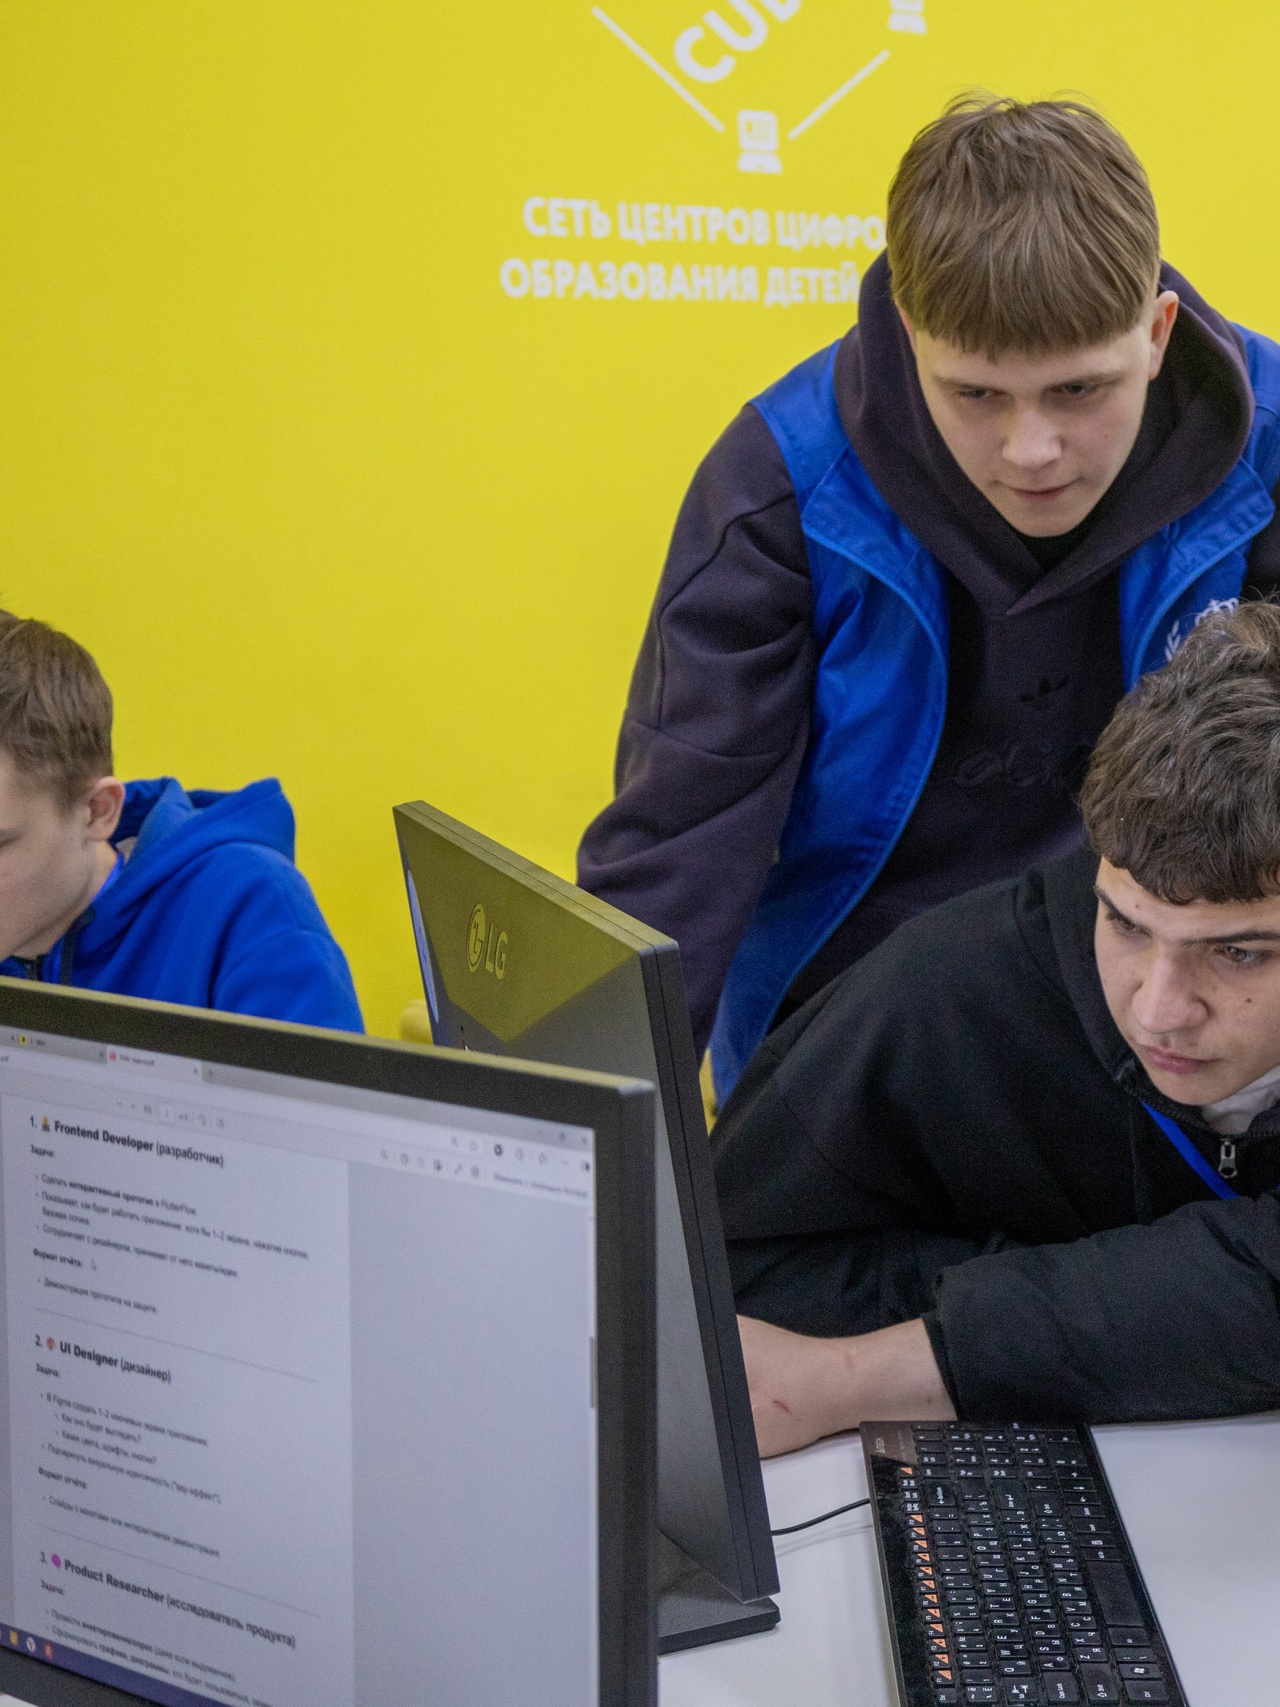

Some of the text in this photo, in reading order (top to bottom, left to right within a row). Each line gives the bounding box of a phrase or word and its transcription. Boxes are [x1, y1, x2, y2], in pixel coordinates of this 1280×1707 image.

[522, 195, 886, 252] СЕТЬ ЦЕНТРОВ ЦИФРО
[500, 257, 860, 308] ОБРАЗОВАНИЯ ДЕТЕЙ
[484, 923, 508, 980] LG
[54, 1121, 98, 1139] Frontend
[102, 1130, 152, 1152] Developer
[156, 1140, 223, 1168] (разработчик)
[59, 1341, 70, 1354] UI
[73, 1345, 118, 1368] Designer
[120, 1357, 171, 1384] (дизайнер)
[64, 1558, 103, 1581] Product
[105, 1573, 164, 1603] Researcher
[167, 1594, 244, 1631] (исследователь
[246, 1622, 296, 1650] продукта)
